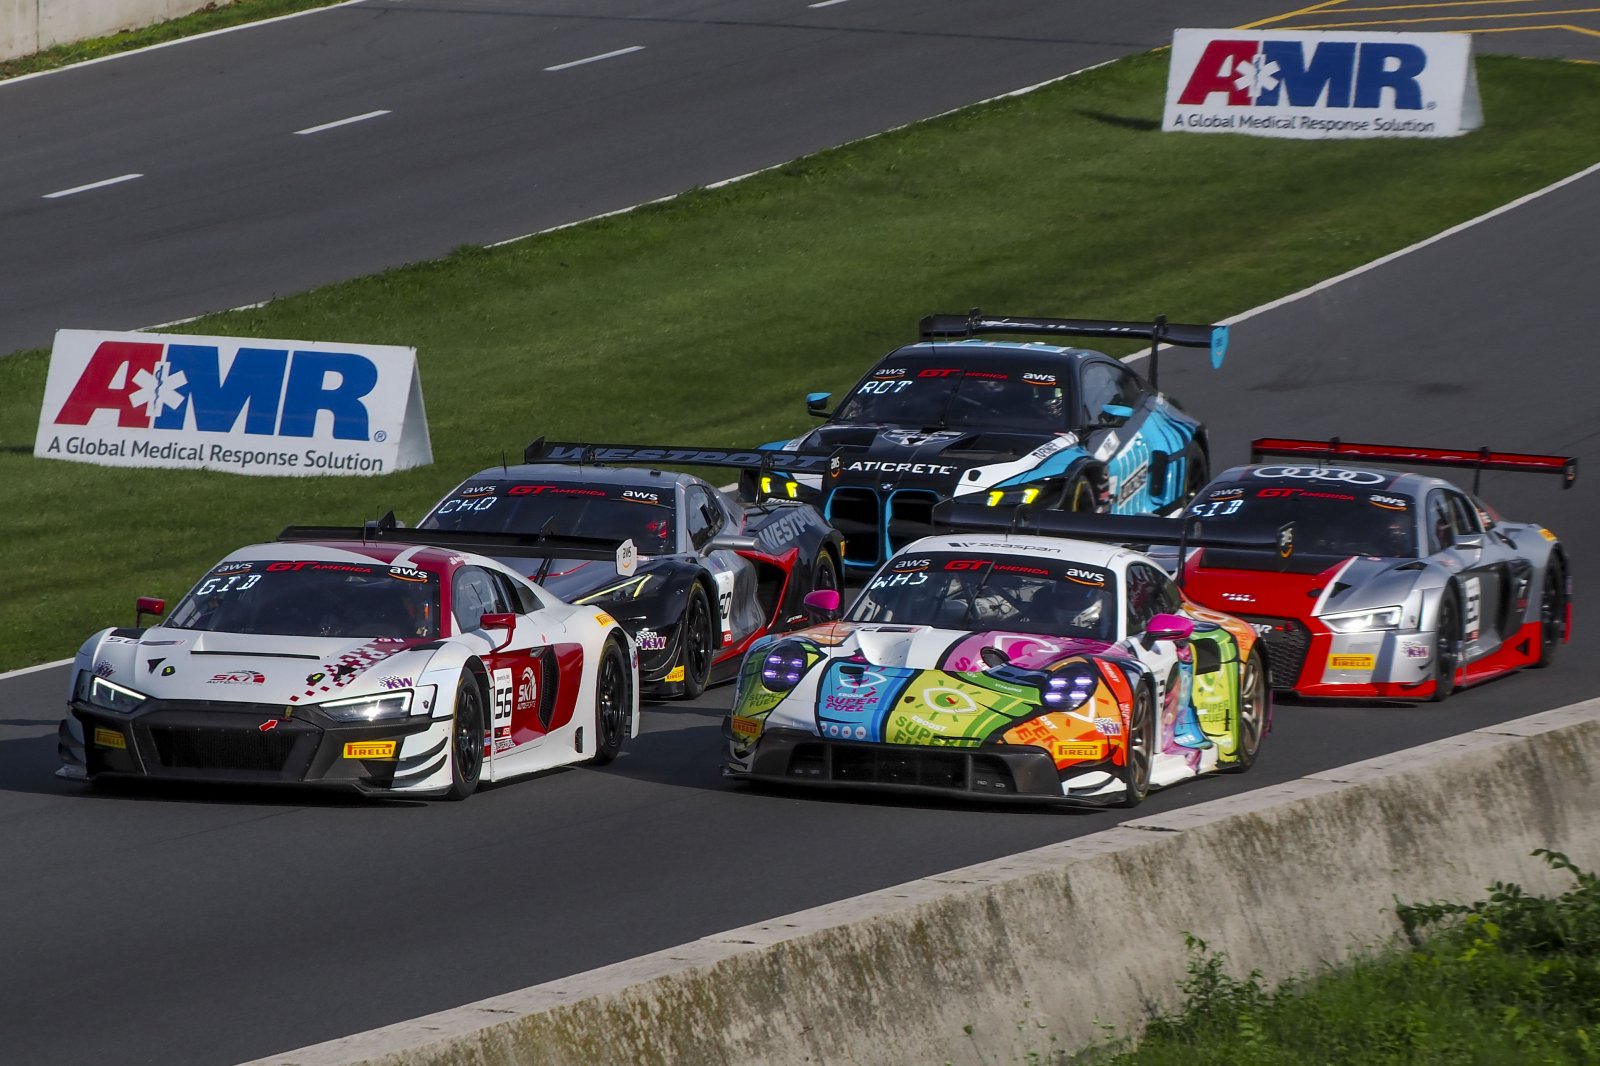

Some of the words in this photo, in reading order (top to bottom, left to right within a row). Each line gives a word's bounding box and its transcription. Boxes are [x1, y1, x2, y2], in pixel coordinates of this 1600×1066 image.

[1177, 39, 1427, 110] AMR
[1174, 115, 1184, 126] A
[1187, 113, 1234, 129] Global
[1239, 114, 1297, 130] Medical
[1301, 116, 1368, 132] Response
[1373, 117, 1435, 133] Solution
[875, 368, 907, 376] aws
[918, 369, 961, 378] GT
[960, 371, 1008, 379] MERICA
[1023, 372, 1056, 382] aws
[53, 341, 378, 442] AMR
[857, 380, 914, 394] ROT
[47, 436, 61, 454] A
[66, 437, 126, 458] Global
[130, 440, 204, 462] Medical
[209, 444, 298, 469] Response
[303, 449, 384, 472] Solution
[547, 446, 827, 468] WESTPORT
[463, 485, 497, 494] aws
[508, 485, 557, 495] GT
[551, 489, 607, 497] AMERICA
[623, 490, 659, 501] aws
[1210, 488, 1245, 498] aws
[1256, 488, 1304, 498] GT
[1300, 491, 1354, 501] AMERICA
[1370, 494, 1407, 507] aws
[977, 542, 1062, 554] seaspan
[217, 562, 254, 573] aws
[266, 561, 317, 573] GT
[311, 564, 372, 573] AMERICA
[894, 559, 932, 569] aws
[943, 559, 993, 571] GT
[992, 564, 1049, 576] AMERICA
[389, 566, 428, 579] aws
[1067, 567, 1105, 582] aws
[641, 637, 666, 650] KW
[1332, 656, 1371, 667] PIRELLI
[385, 677, 413, 690] KW
[494, 686, 513, 719] 56
[826, 695, 879, 705] SUPER
[825, 702, 865, 713] FUEL
[347, 743, 393, 756] PIRELLI
[1058, 744, 1098, 756] PIRELLI
